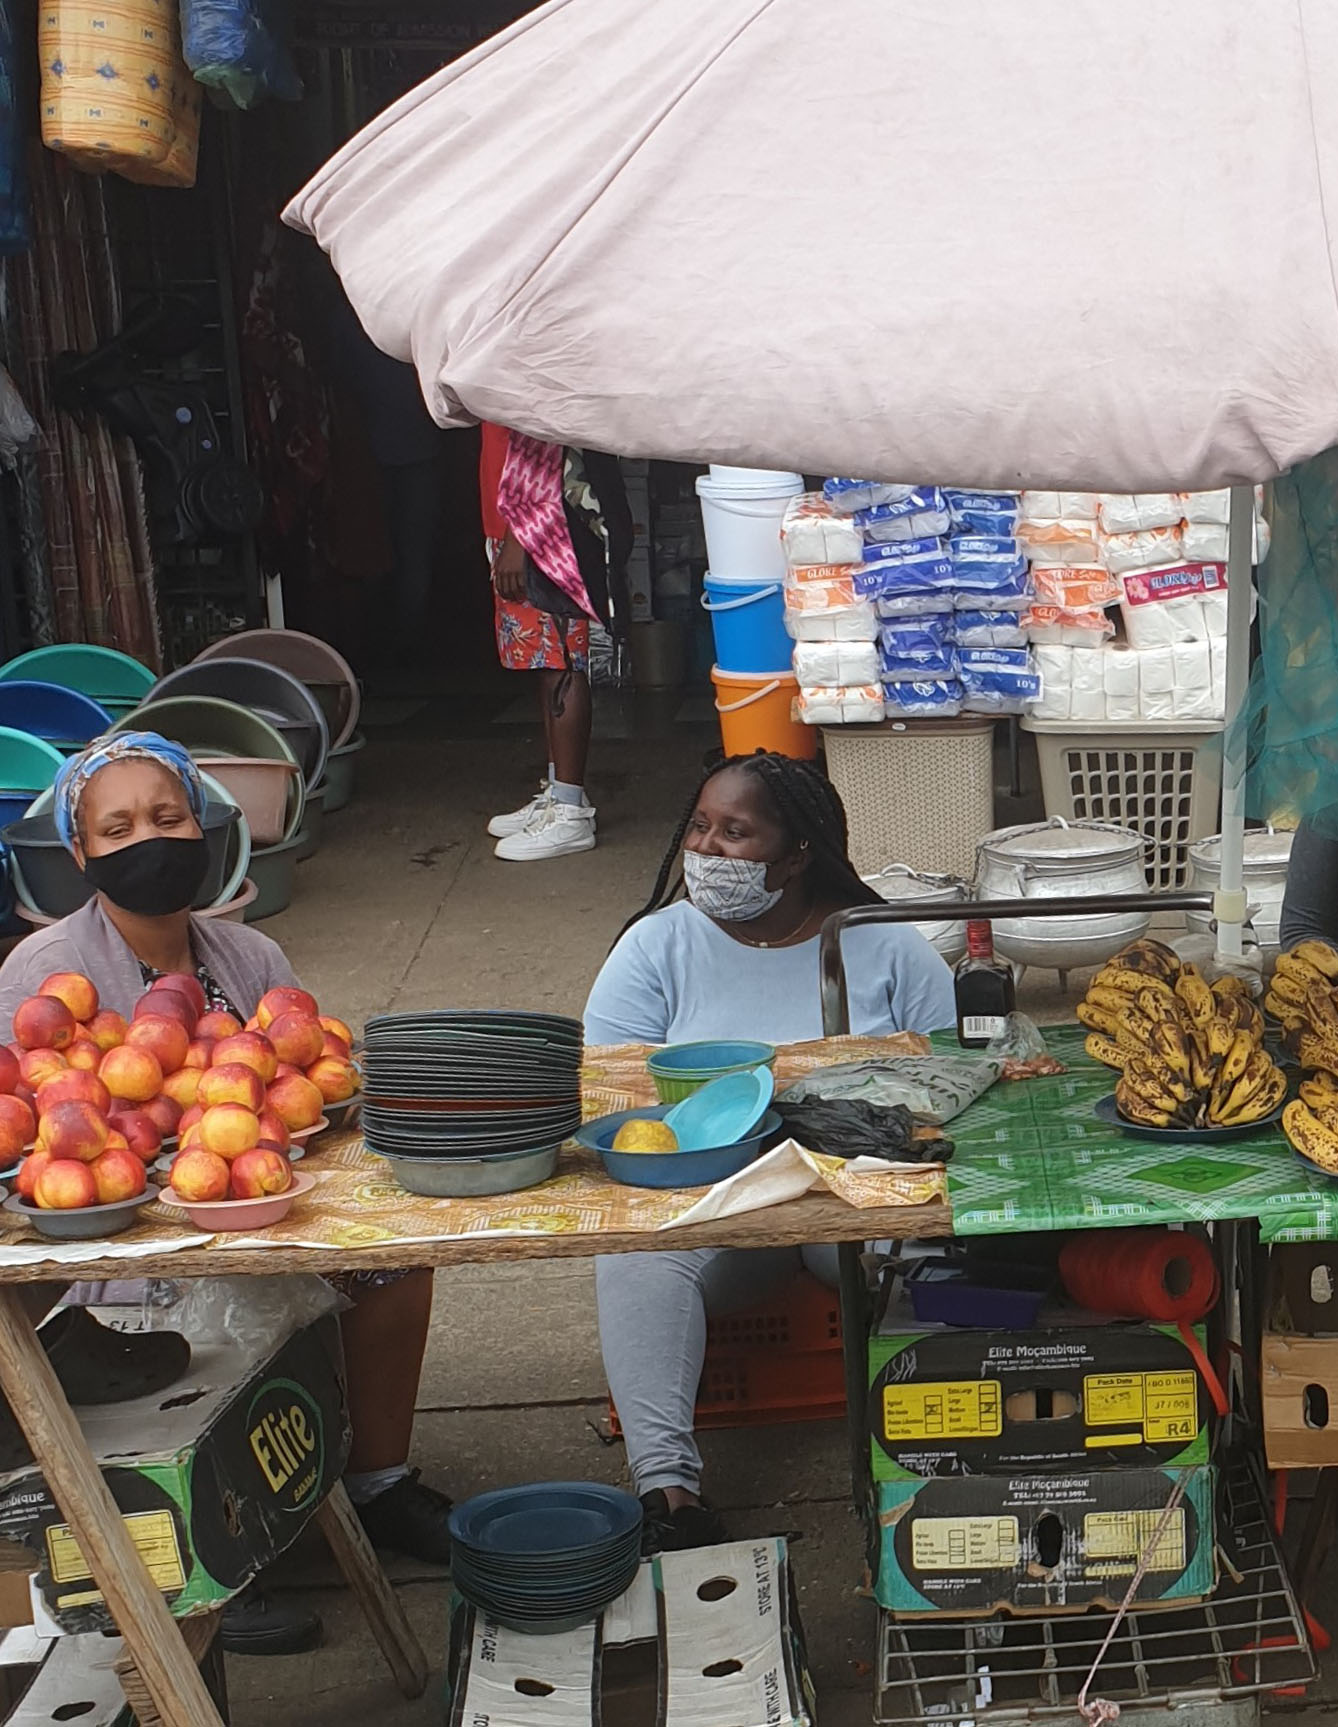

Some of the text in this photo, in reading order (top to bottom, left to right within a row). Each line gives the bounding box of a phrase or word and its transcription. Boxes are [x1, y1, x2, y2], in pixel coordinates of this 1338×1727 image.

[988, 1343, 1087, 1358] Elite Moçambique
[1168, 1421, 1192, 1436] R4
[249, 1405, 315, 1493] Elite
[757, 1569, 770, 1585] AT
[757, 1583, 772, 1617] STORE
[480, 1638, 497, 1662] CARE
[764, 1667, 779, 1693] CARE
